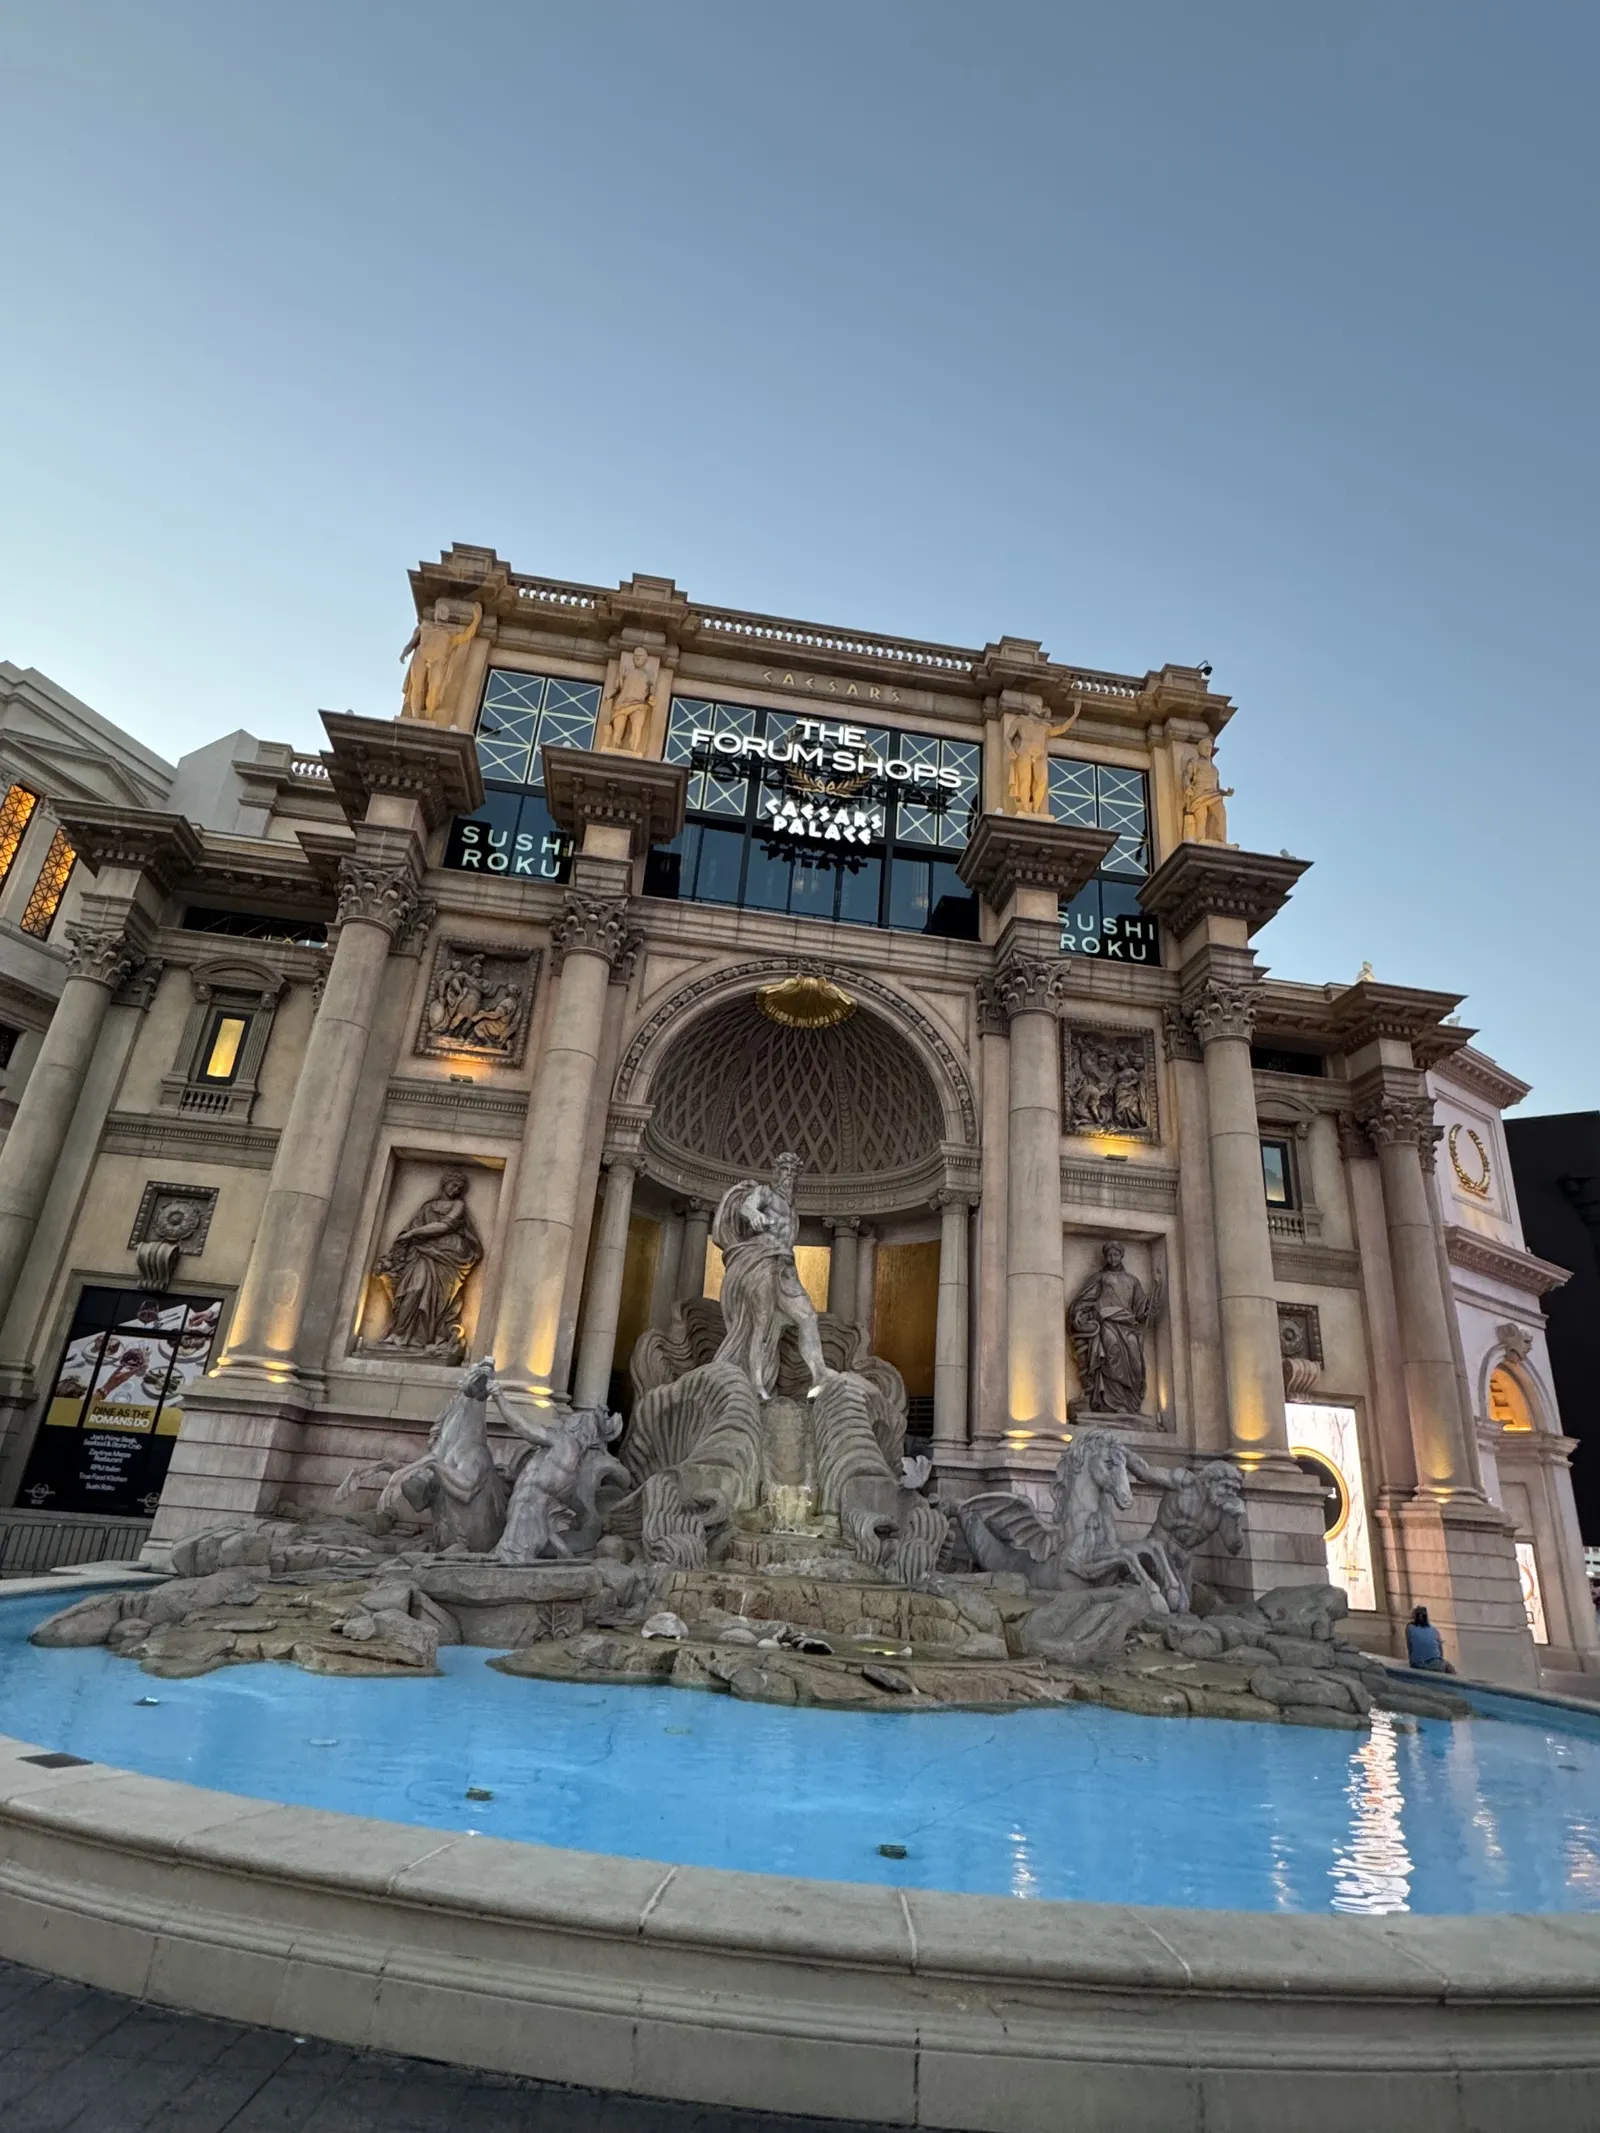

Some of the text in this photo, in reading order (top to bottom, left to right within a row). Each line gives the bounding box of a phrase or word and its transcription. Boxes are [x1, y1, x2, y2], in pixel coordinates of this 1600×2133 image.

[763, 670, 901, 703] CAESARS
[796, 719, 868, 750] THE
[690, 728, 963, 789] FORUM SHOPS
[764, 797, 883, 830] CAESARS
[461, 825, 575, 858] SUSHI
[772, 815, 873, 847] PALACE
[461, 848, 561, 878] ROKU
[1057, 911, 1154, 940] SUSHI
[1060, 933, 1147, 961] ROKU
[88, 1414, 150, 1428] ROMANS DO
[92, 1406, 151, 1419] DINE AS THE
